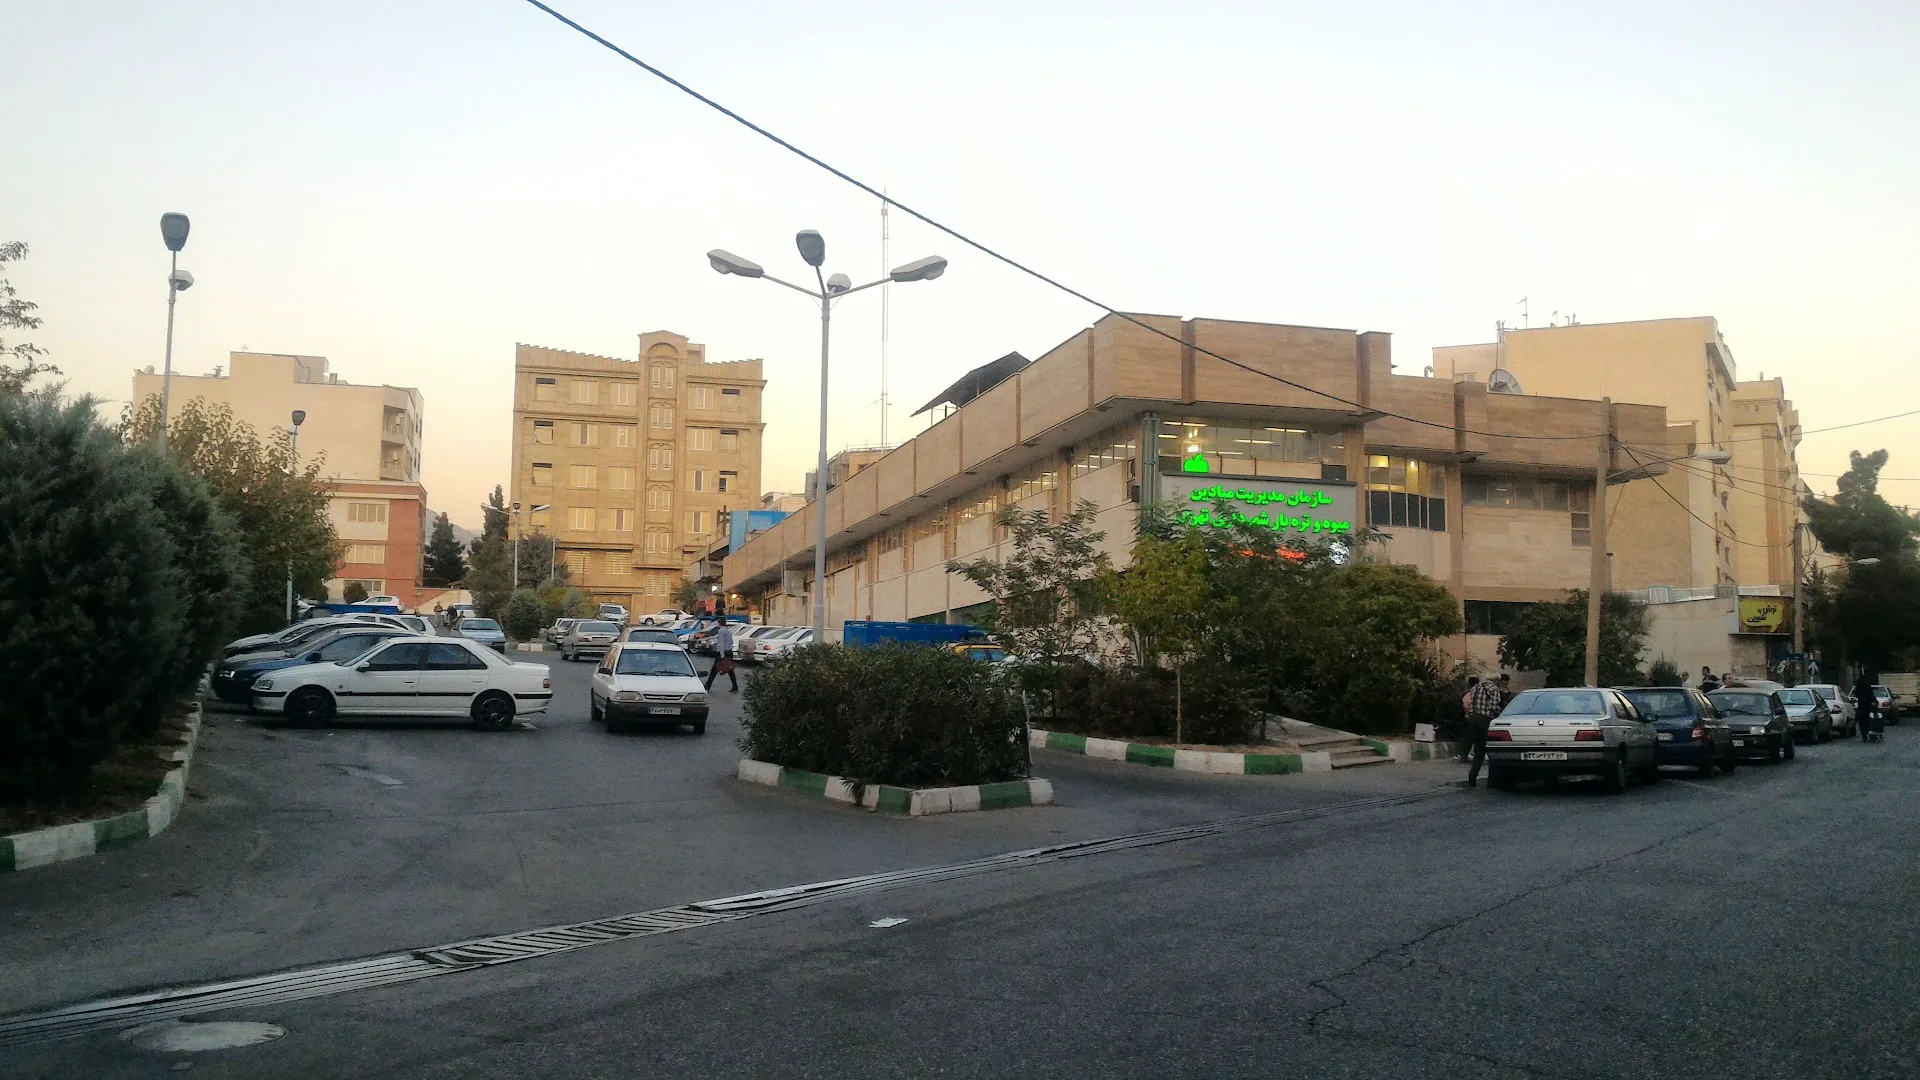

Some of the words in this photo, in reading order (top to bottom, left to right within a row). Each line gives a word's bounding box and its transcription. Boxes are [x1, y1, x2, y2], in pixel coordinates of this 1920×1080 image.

[1190, 484, 1235, 501] میادین
[1236, 487, 1285, 505] مدیریت
[1287, 489, 1333, 508] سازمان
[1271, 513, 1290, 532] بار
[1291, 515, 1312, 531] تره
[1312, 519, 1321, 534] و
[1322, 518, 1351, 534] میوه
